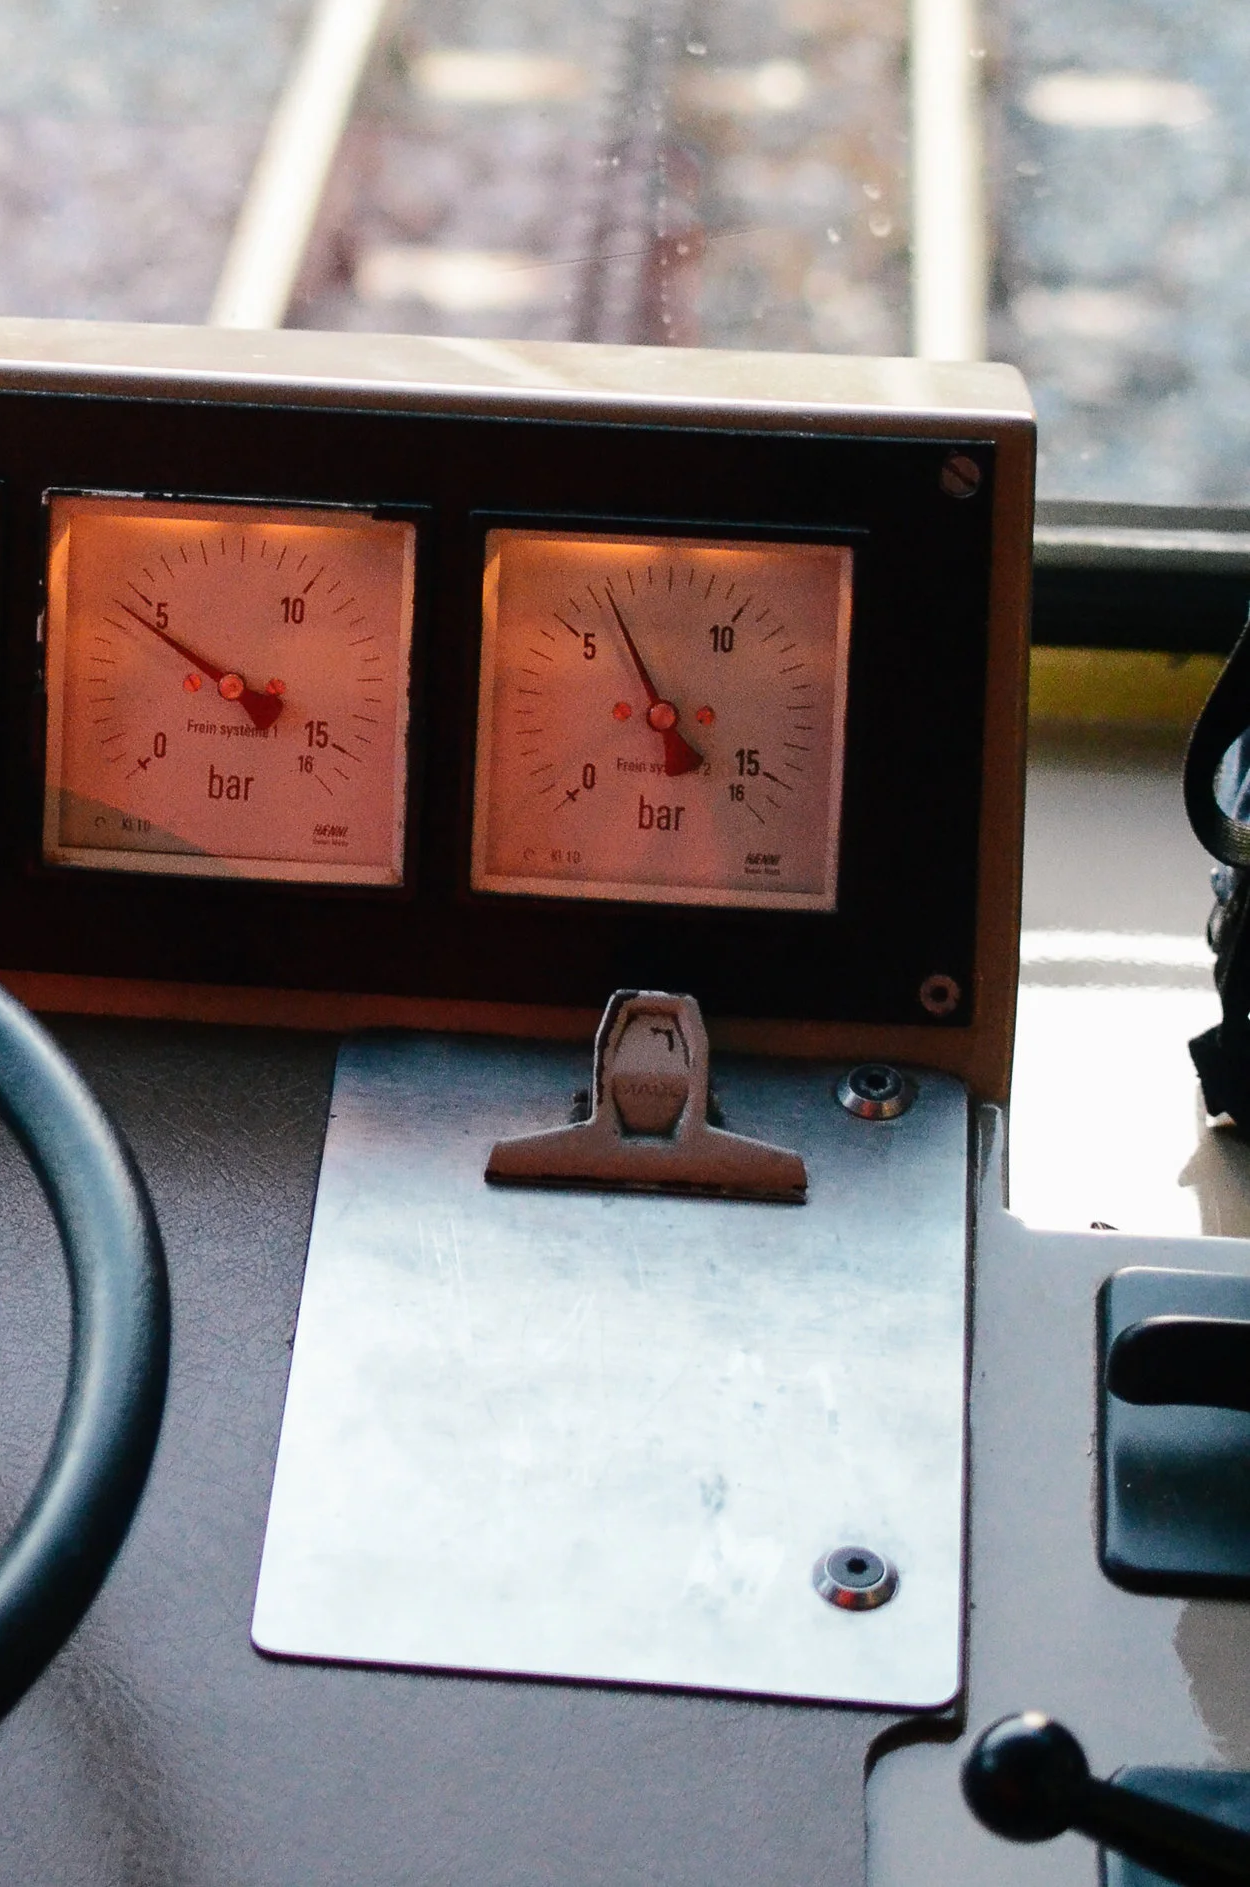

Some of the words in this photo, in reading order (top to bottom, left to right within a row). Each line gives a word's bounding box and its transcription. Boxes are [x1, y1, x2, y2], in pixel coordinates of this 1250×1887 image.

[155, 602, 169, 630] 5
[280, 596, 305, 624] 10
[583, 632, 597, 660] 5
[709, 624, 735, 653] 10
[186, 718, 217, 735] Frein
[304, 720, 330, 749] 15
[153, 732, 167, 759] 0
[297, 755, 314, 774] 16
[582, 763, 596, 790] 0
[616, 757, 647, 773] Frein
[703, 762, 712, 776] 2
[735, 748, 760, 777] 15
[208, 763, 255, 802] bar
[728, 783, 745, 802] 16
[638, 794, 686, 832] bar
